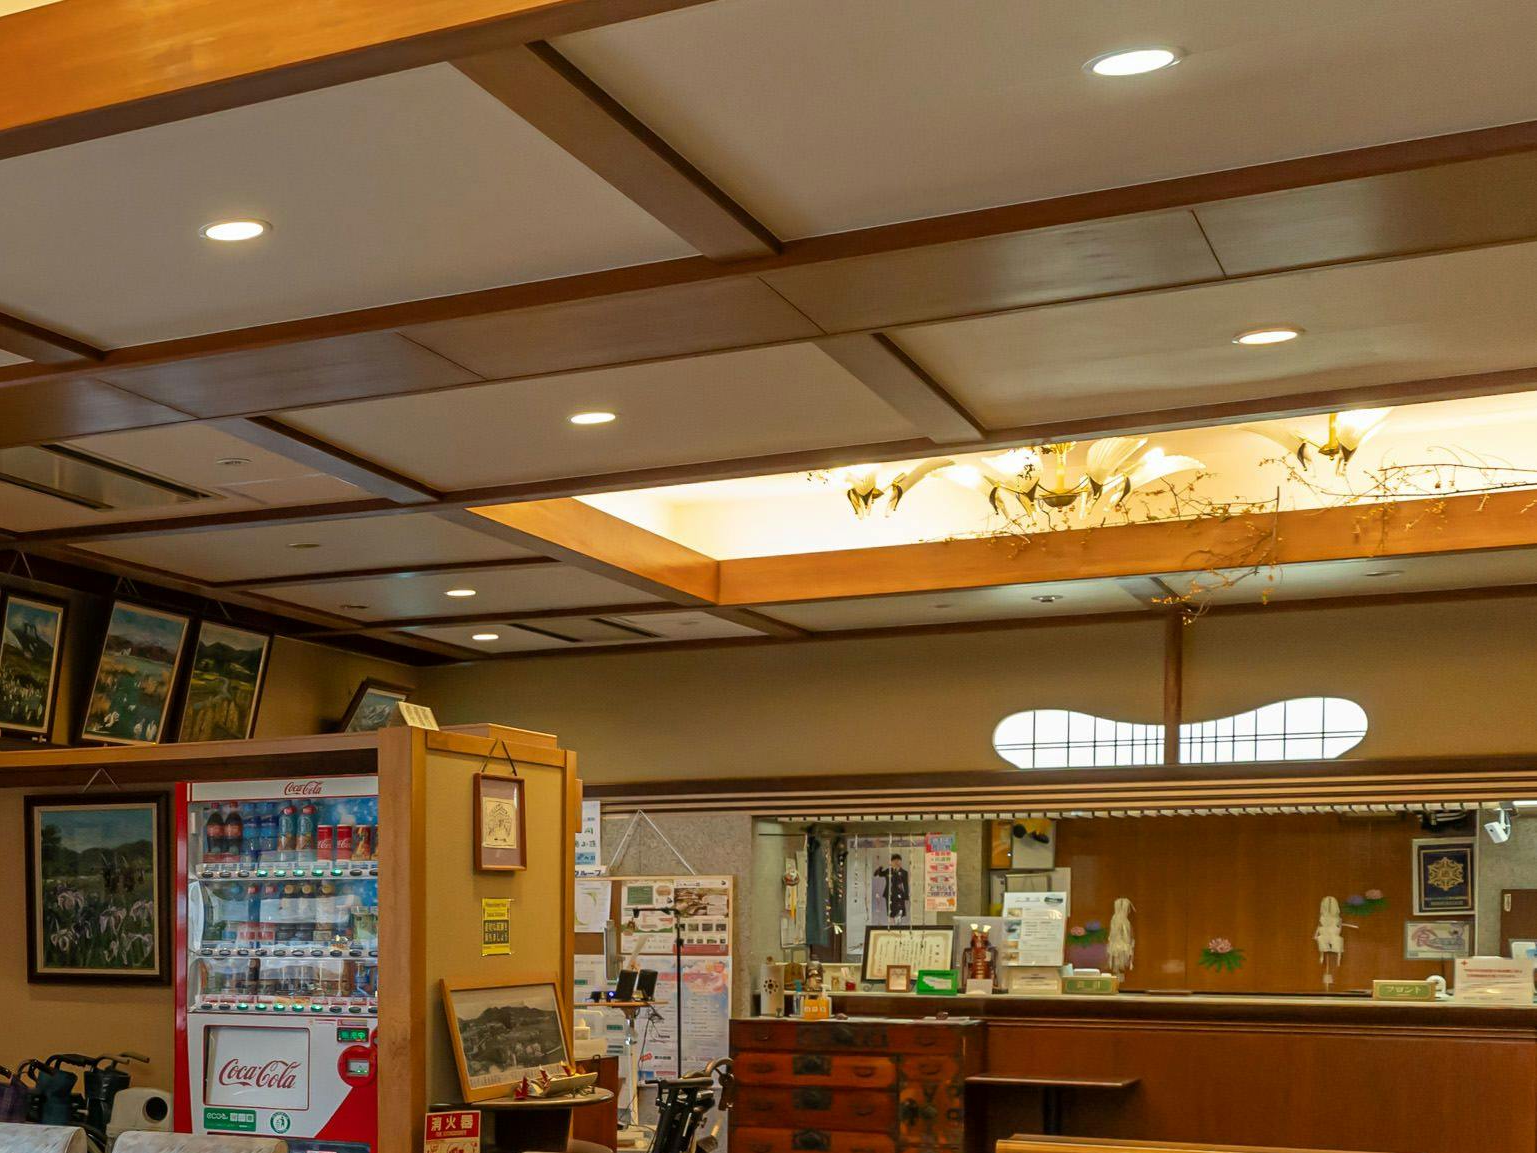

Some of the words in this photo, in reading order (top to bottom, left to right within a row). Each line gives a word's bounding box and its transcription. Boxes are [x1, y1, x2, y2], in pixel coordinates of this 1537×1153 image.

[219, 1058, 301, 1089] Coca-Cola
[431, 1114, 474, 1132] 消火器
